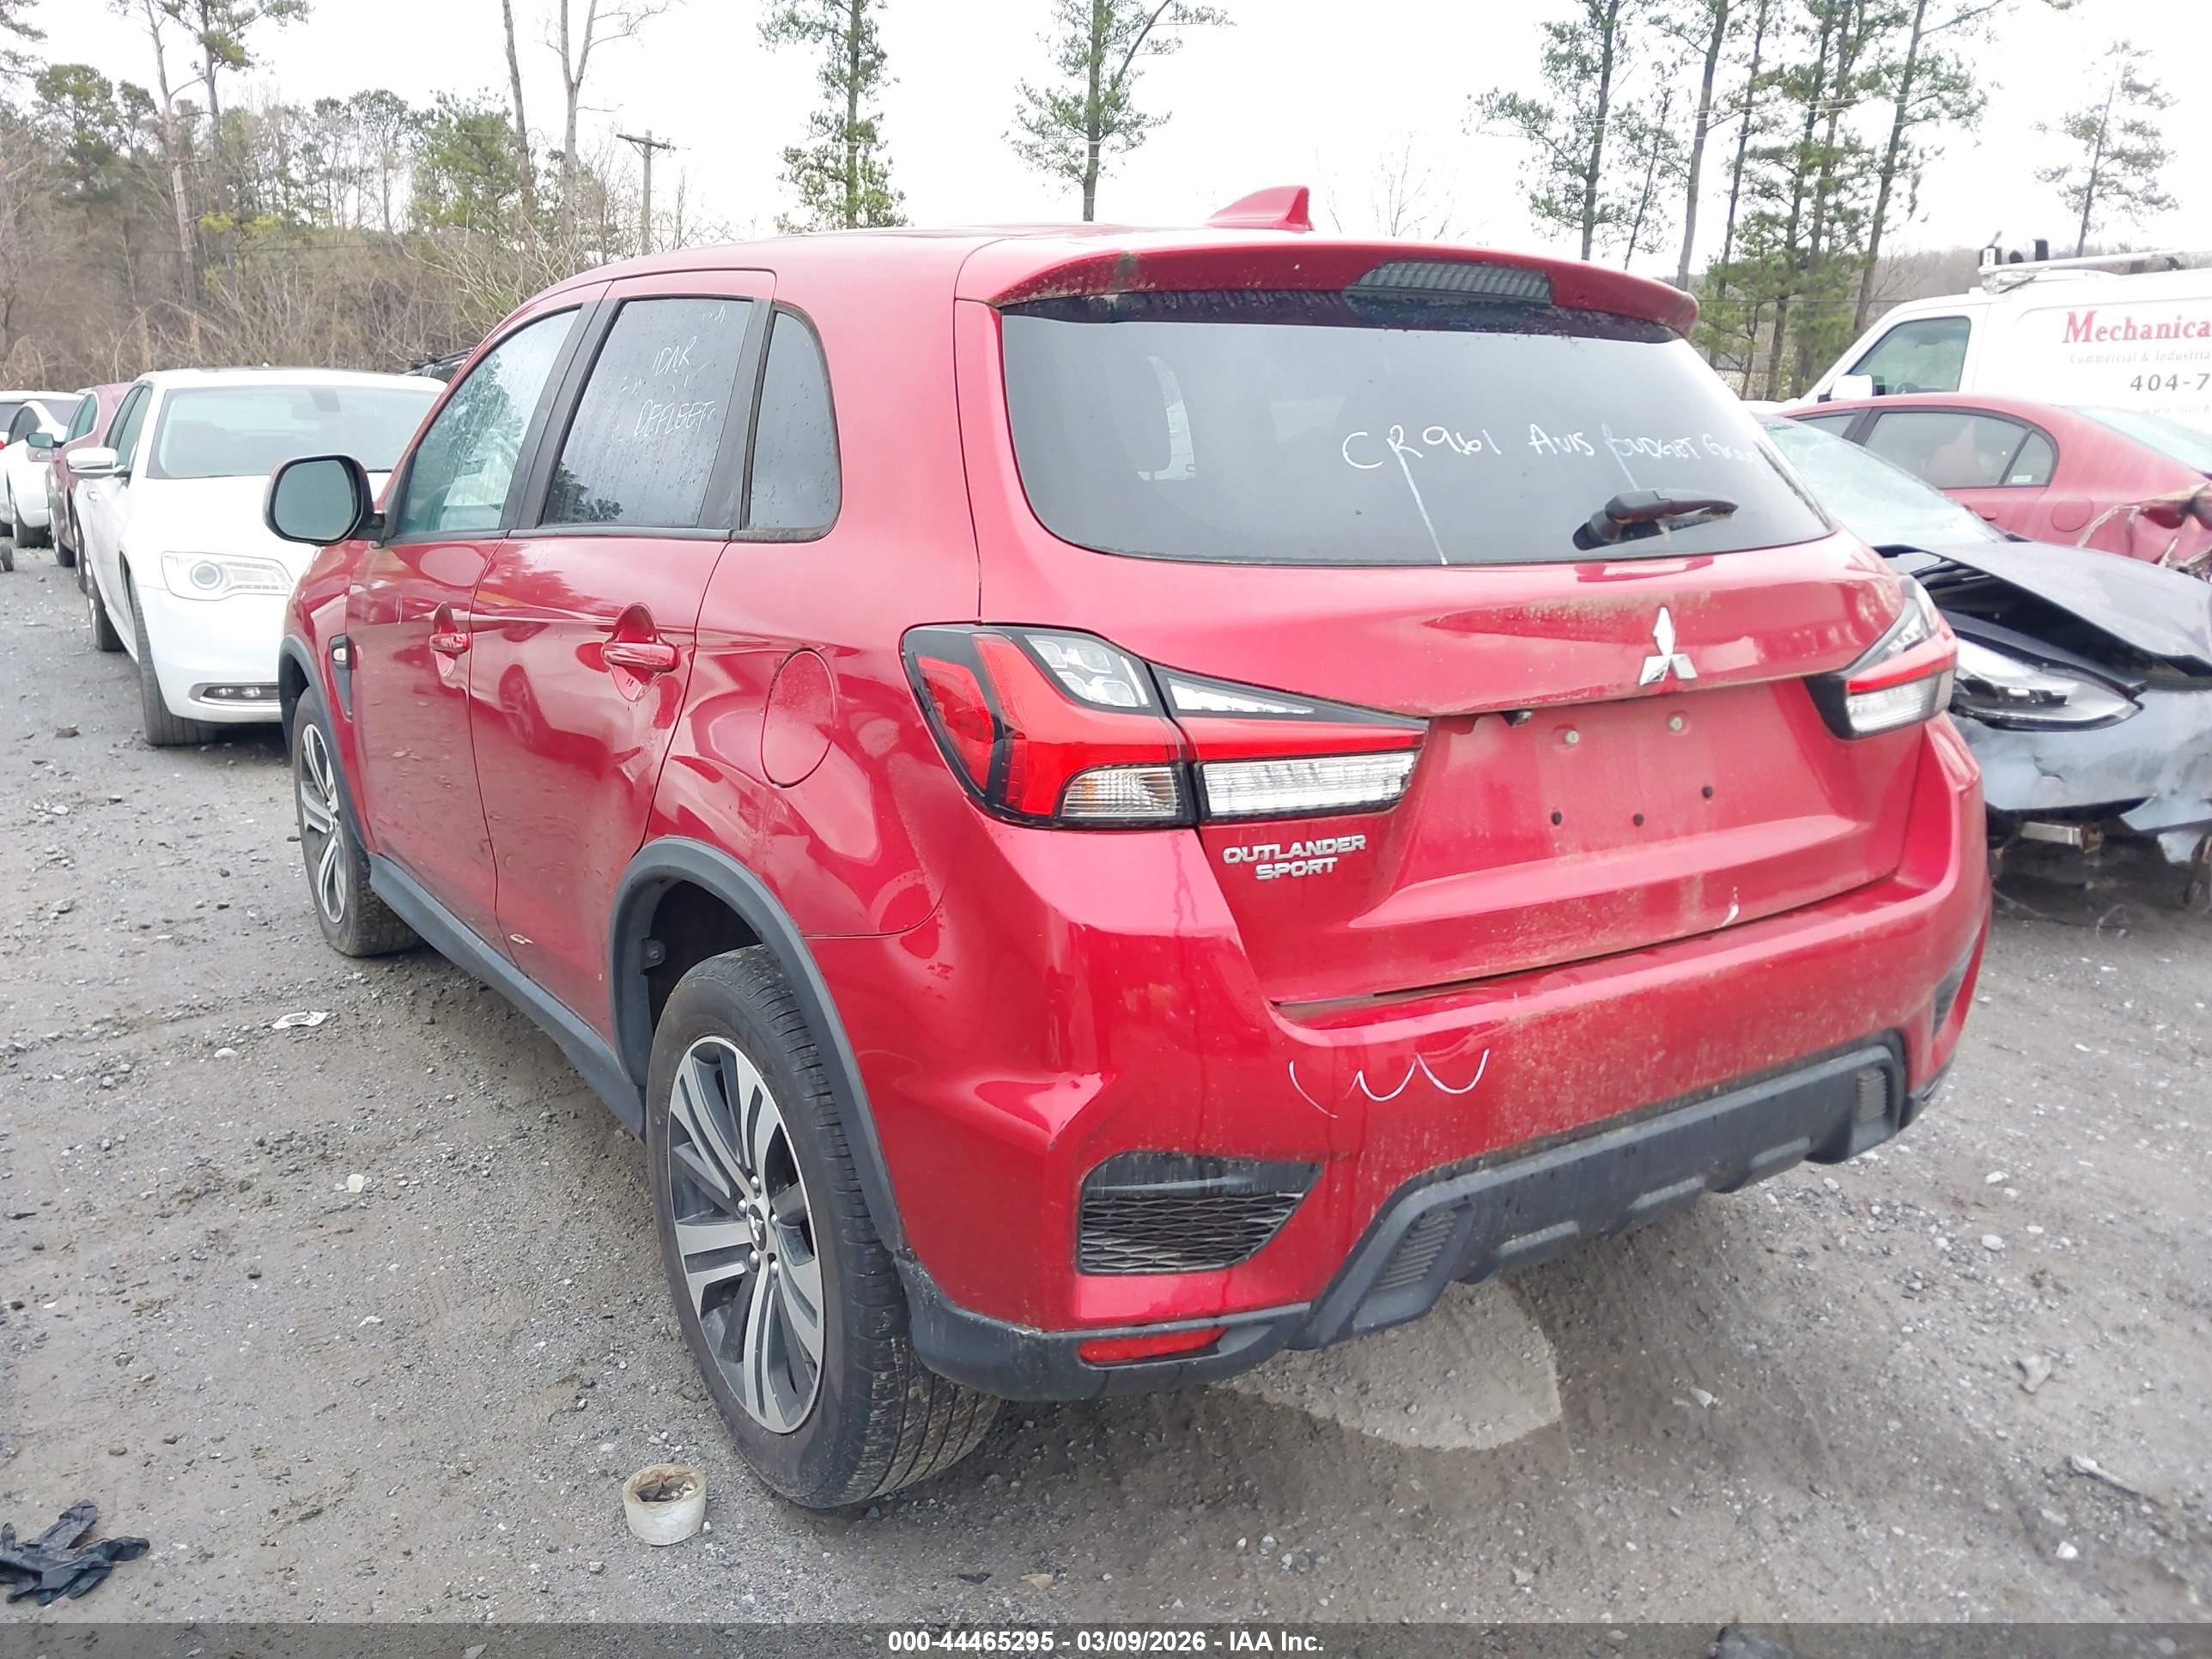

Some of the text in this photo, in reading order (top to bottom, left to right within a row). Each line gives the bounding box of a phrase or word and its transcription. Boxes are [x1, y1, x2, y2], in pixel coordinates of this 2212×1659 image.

[2062, 310, 2212, 343] Mechanica
[2130, 373, 2210, 392] 404-7
[1222, 835, 1366, 865] OUTLANDER
[1255, 857, 1338, 880] SPORT
